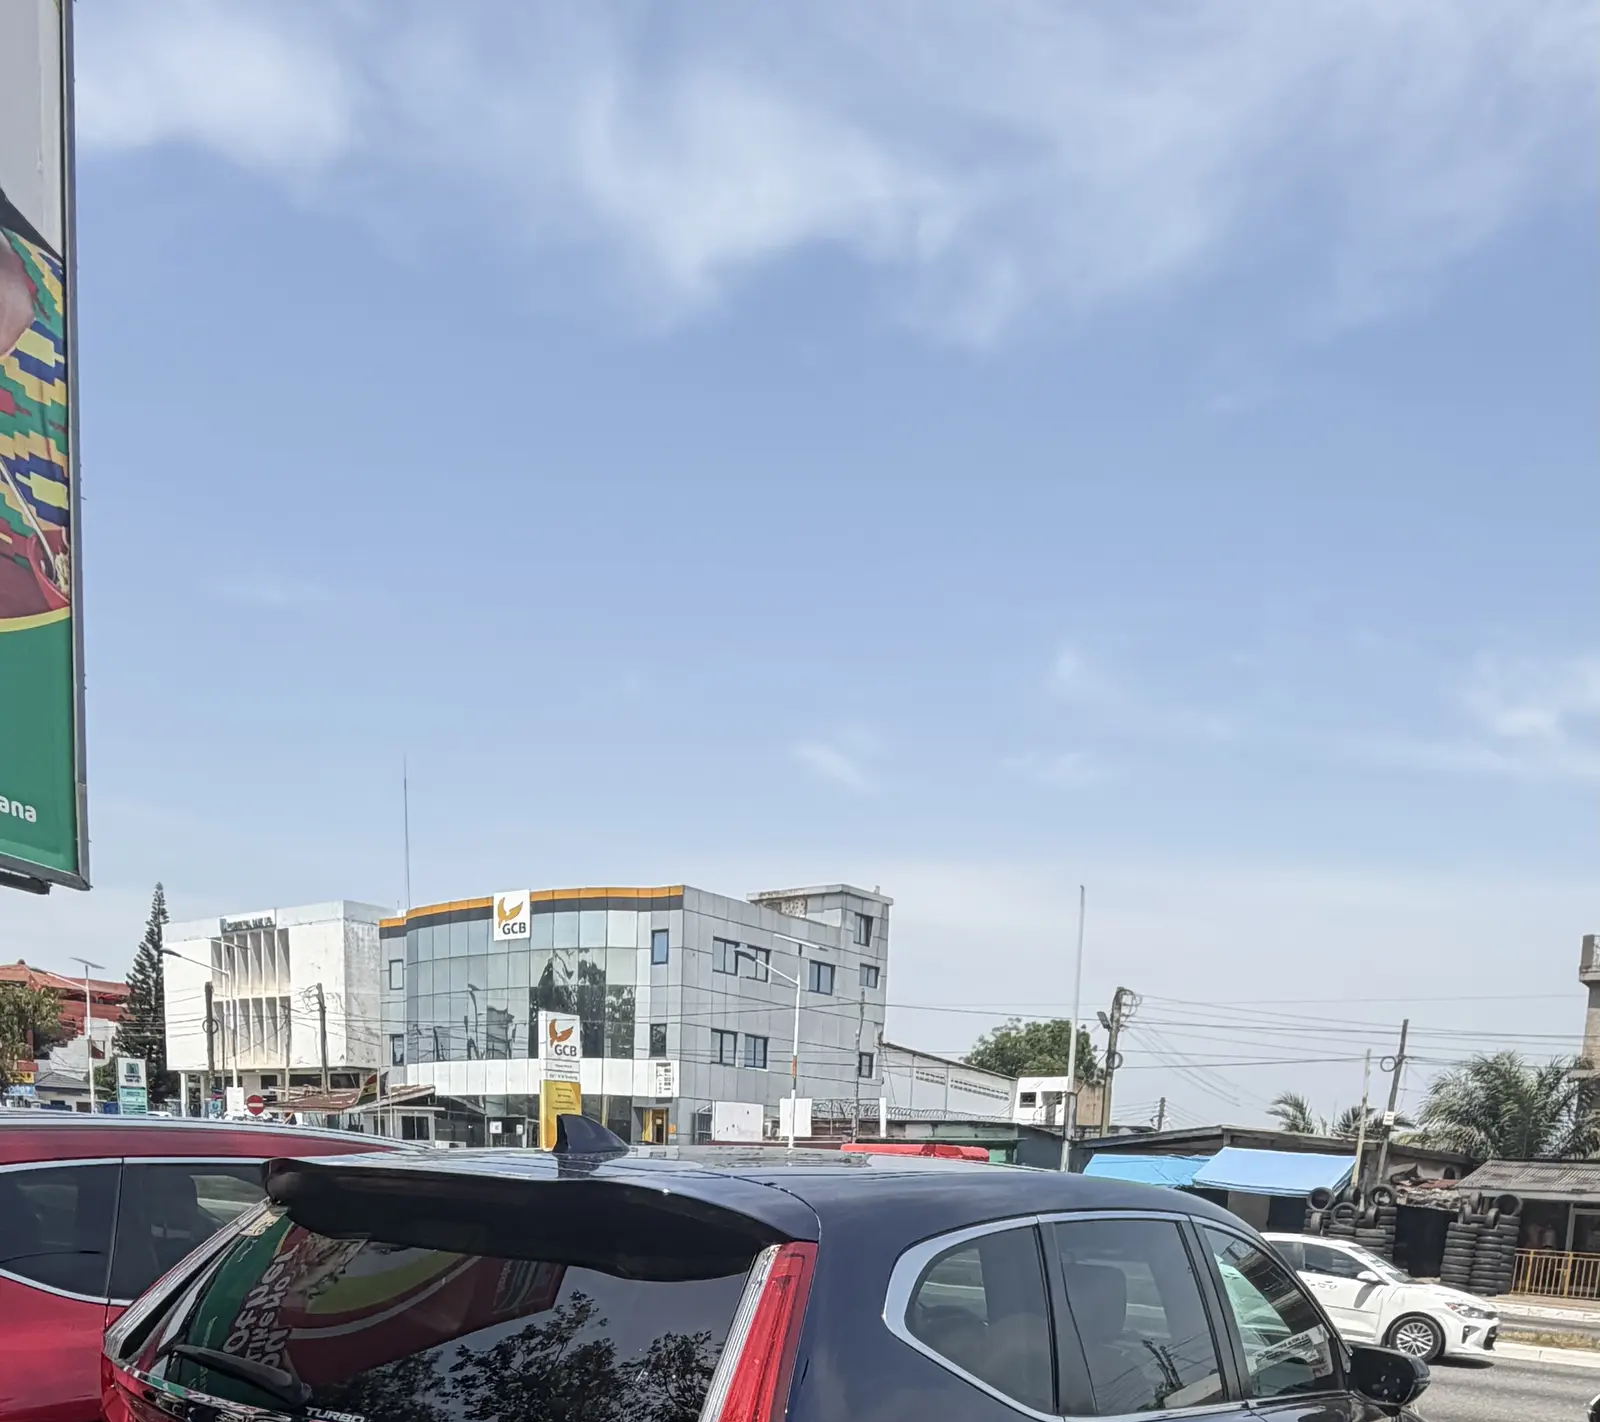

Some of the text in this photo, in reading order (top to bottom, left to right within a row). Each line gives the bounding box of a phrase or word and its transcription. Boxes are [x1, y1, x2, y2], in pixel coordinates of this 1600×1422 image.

[0, 795, 37, 823] ana
[502, 922, 527, 935] GCB
[554, 1044, 577, 1057] GCB
